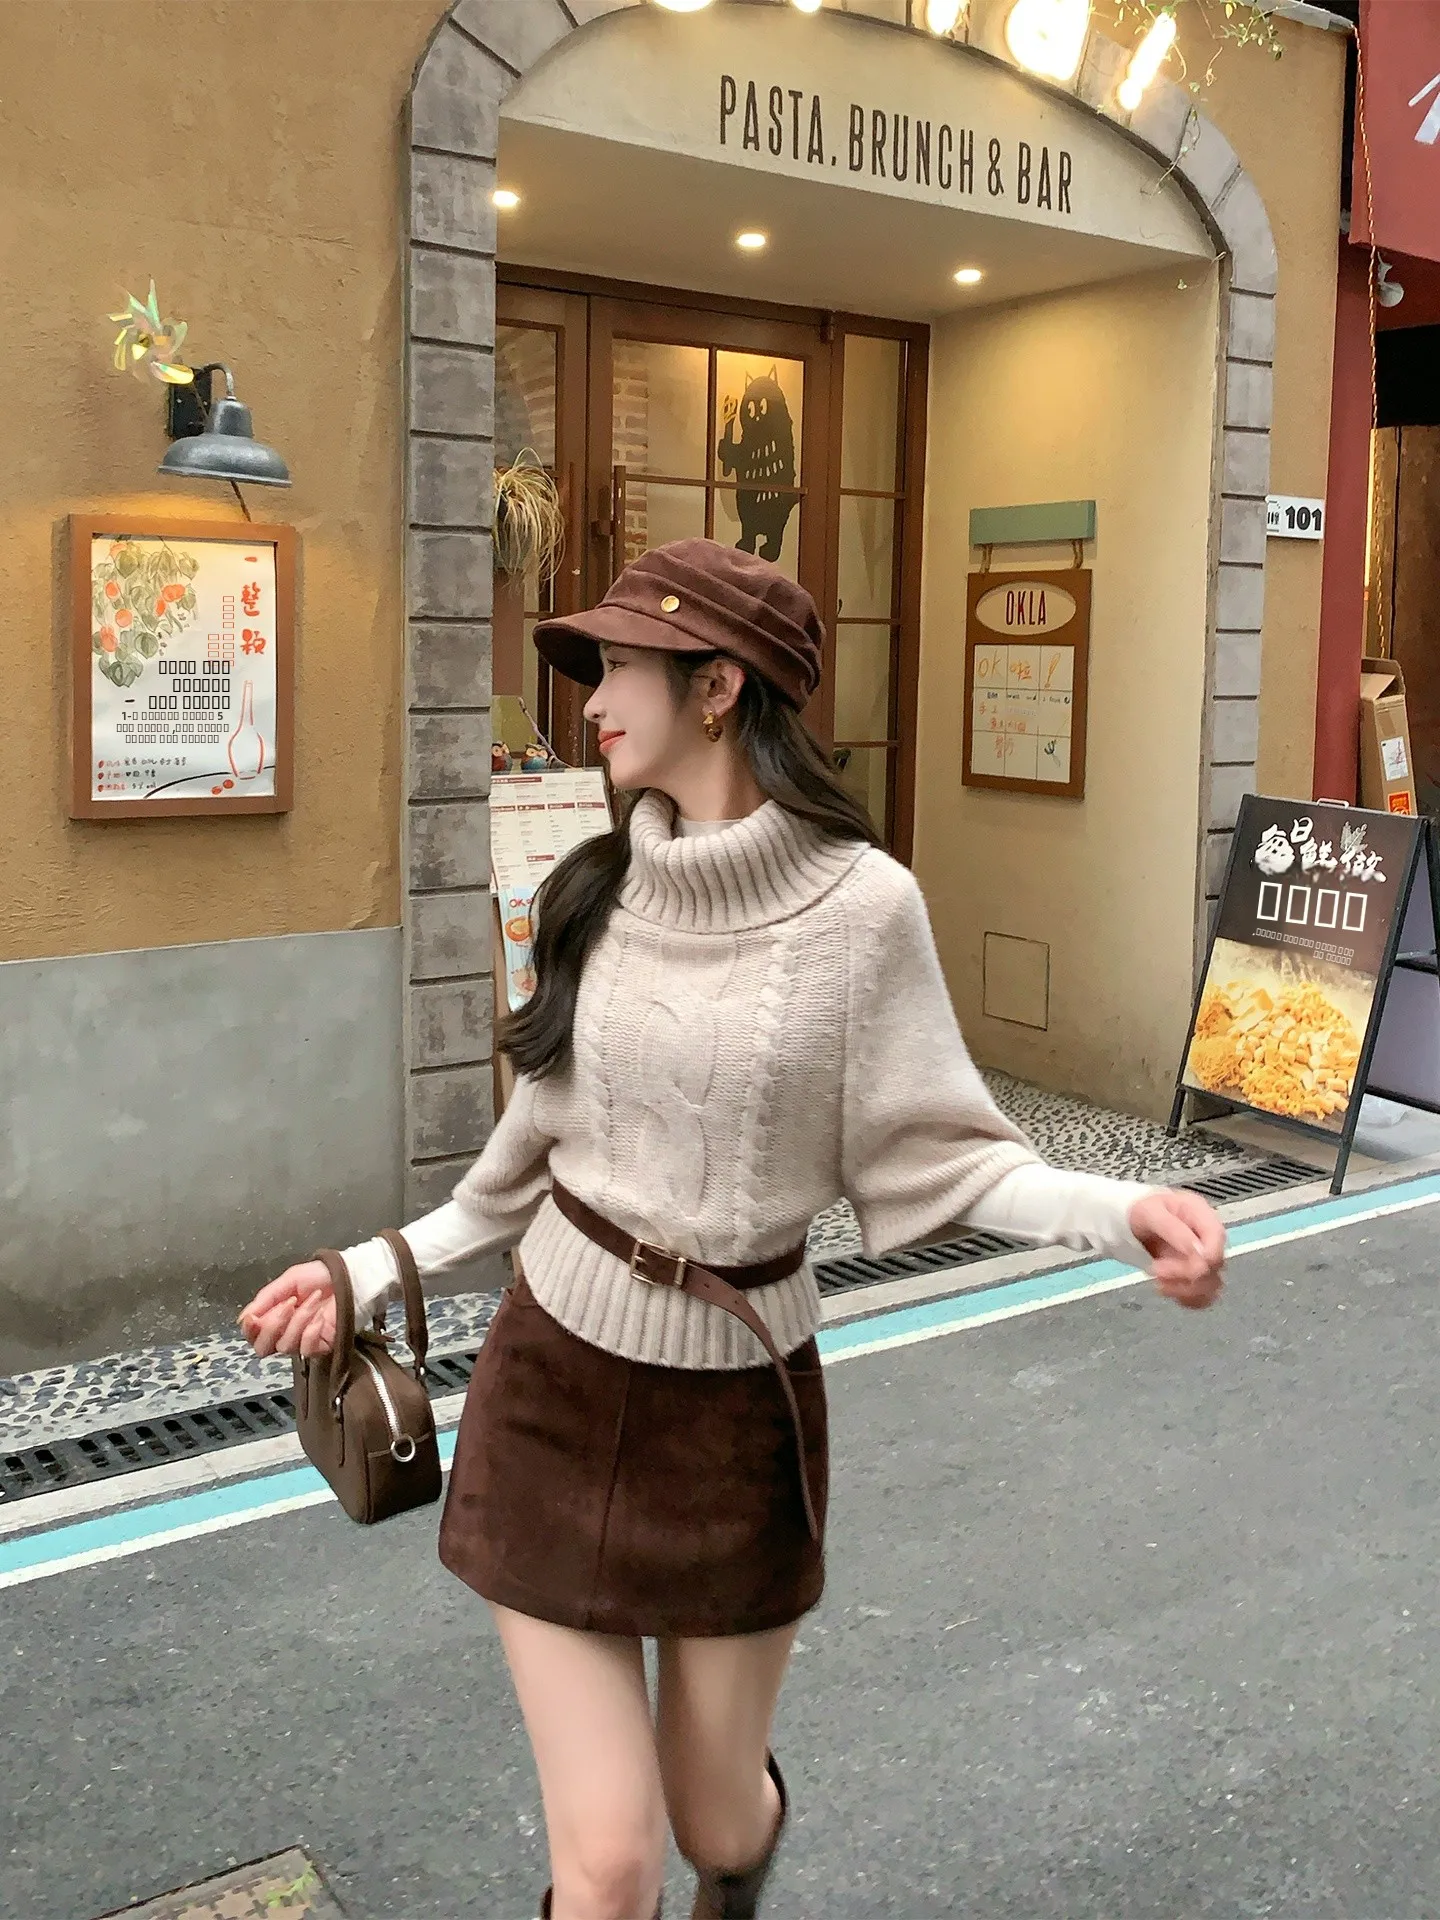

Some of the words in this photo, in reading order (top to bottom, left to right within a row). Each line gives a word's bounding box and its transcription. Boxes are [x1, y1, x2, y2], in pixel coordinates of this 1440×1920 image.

[720, 75, 837, 166] PASTA.
[849, 104, 974, 195] BRUNCH
[988, 138, 1004, 197] &
[1017, 142, 1072, 214] BAR
[1285, 505, 1323, 531] 101
[1006, 590, 1047, 626] OKLA
